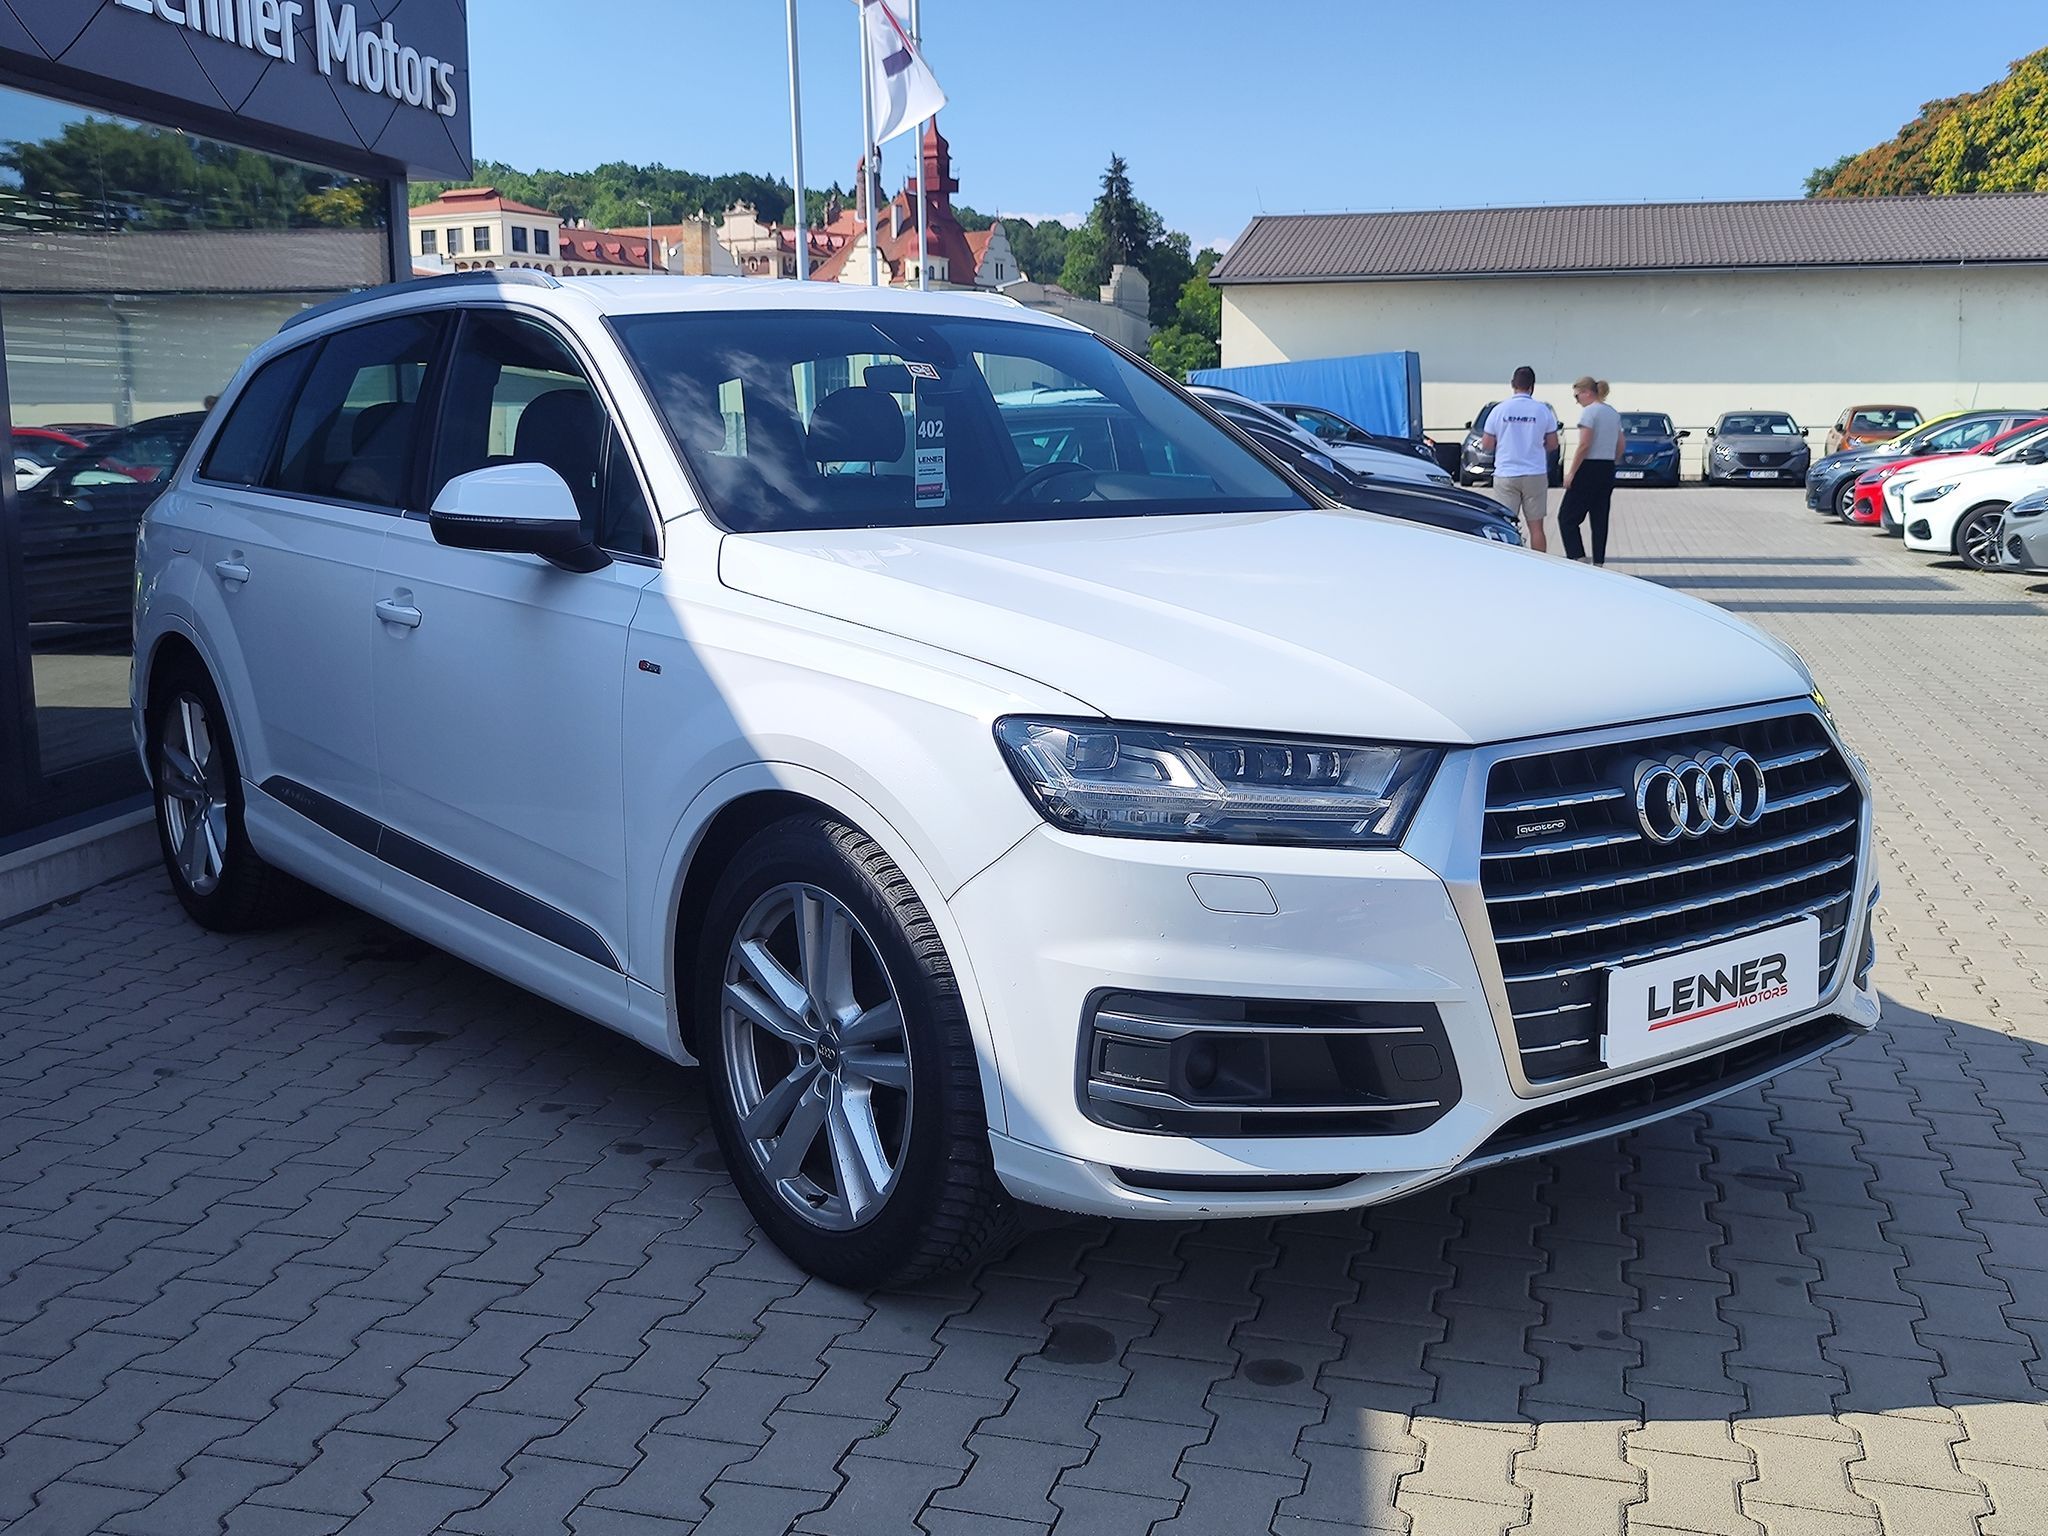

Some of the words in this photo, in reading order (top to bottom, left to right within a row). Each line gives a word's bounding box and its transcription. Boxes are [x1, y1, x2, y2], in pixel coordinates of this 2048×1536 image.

[115, 0, 307, 64] nner
[314, 0, 457, 117] Motors
[918, 420, 944, 438] 402
[1520, 822, 1565, 834] quattro
[1648, 953, 1787, 1021] LENNER
[1738, 985, 1788, 1008] MOTORS
